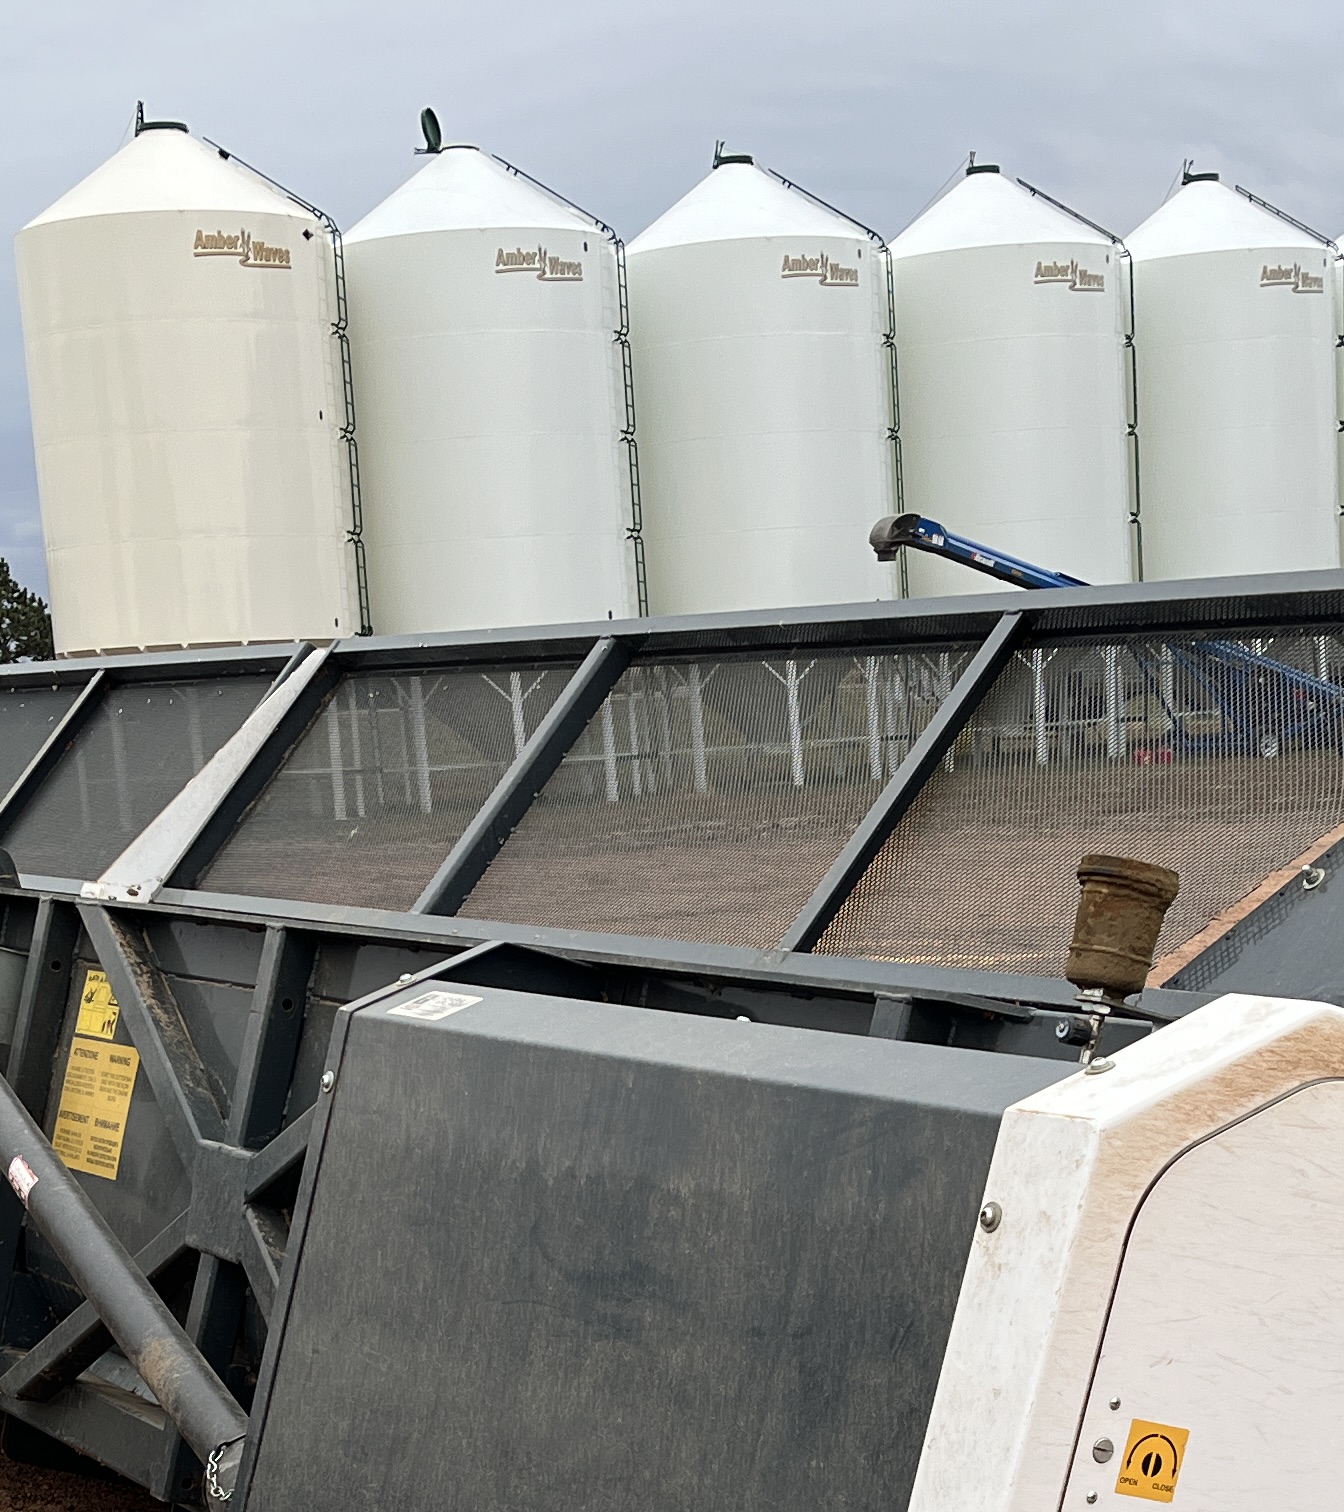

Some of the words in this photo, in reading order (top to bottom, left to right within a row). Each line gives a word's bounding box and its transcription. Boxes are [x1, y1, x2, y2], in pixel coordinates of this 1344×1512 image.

[194, 229, 240, 250] Amber
[252, 241, 290, 263] Waves
[496, 247, 537, 266] Amber
[548, 256, 582, 276] Waves
[782, 254, 819, 272] Amber
[830, 263, 858, 282] Waves
[1035, 261, 1070, 278] Amber
[1261, 264, 1293, 281] Amber
[1119, 1477, 1138, 1486] OPEN
[1152, 1482, 1174, 1493] CLOSE
